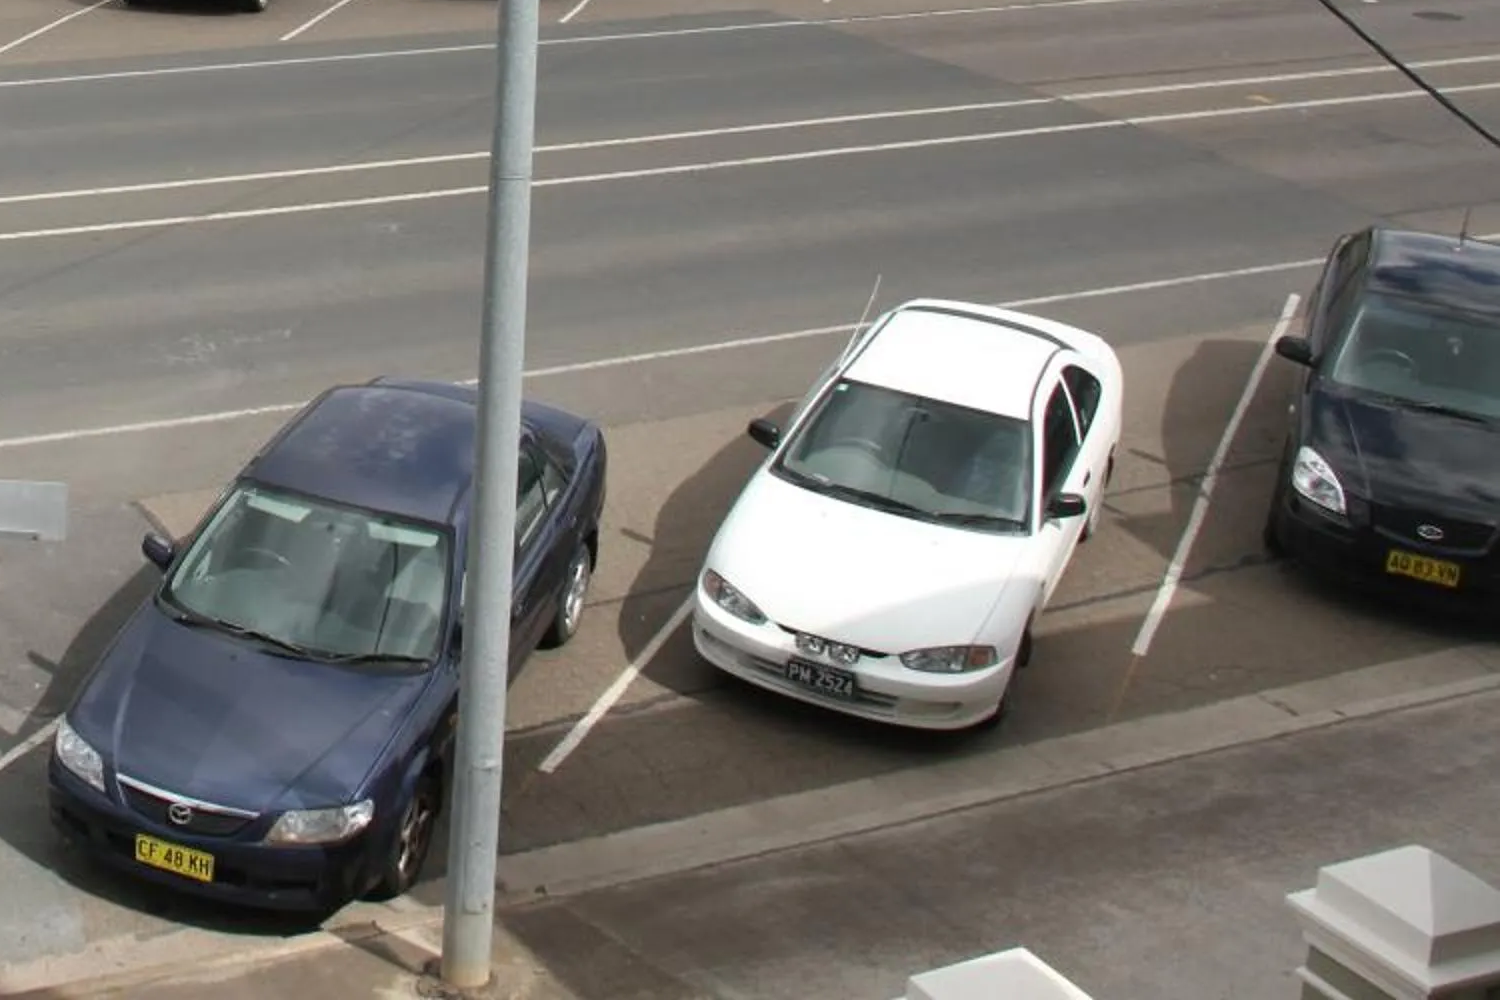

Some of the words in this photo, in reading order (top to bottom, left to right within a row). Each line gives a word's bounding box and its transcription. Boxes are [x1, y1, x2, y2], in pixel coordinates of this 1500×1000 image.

[139, 840, 158, 857] CF
[164, 848, 183, 867] 48
[189, 854, 209, 876] KH
